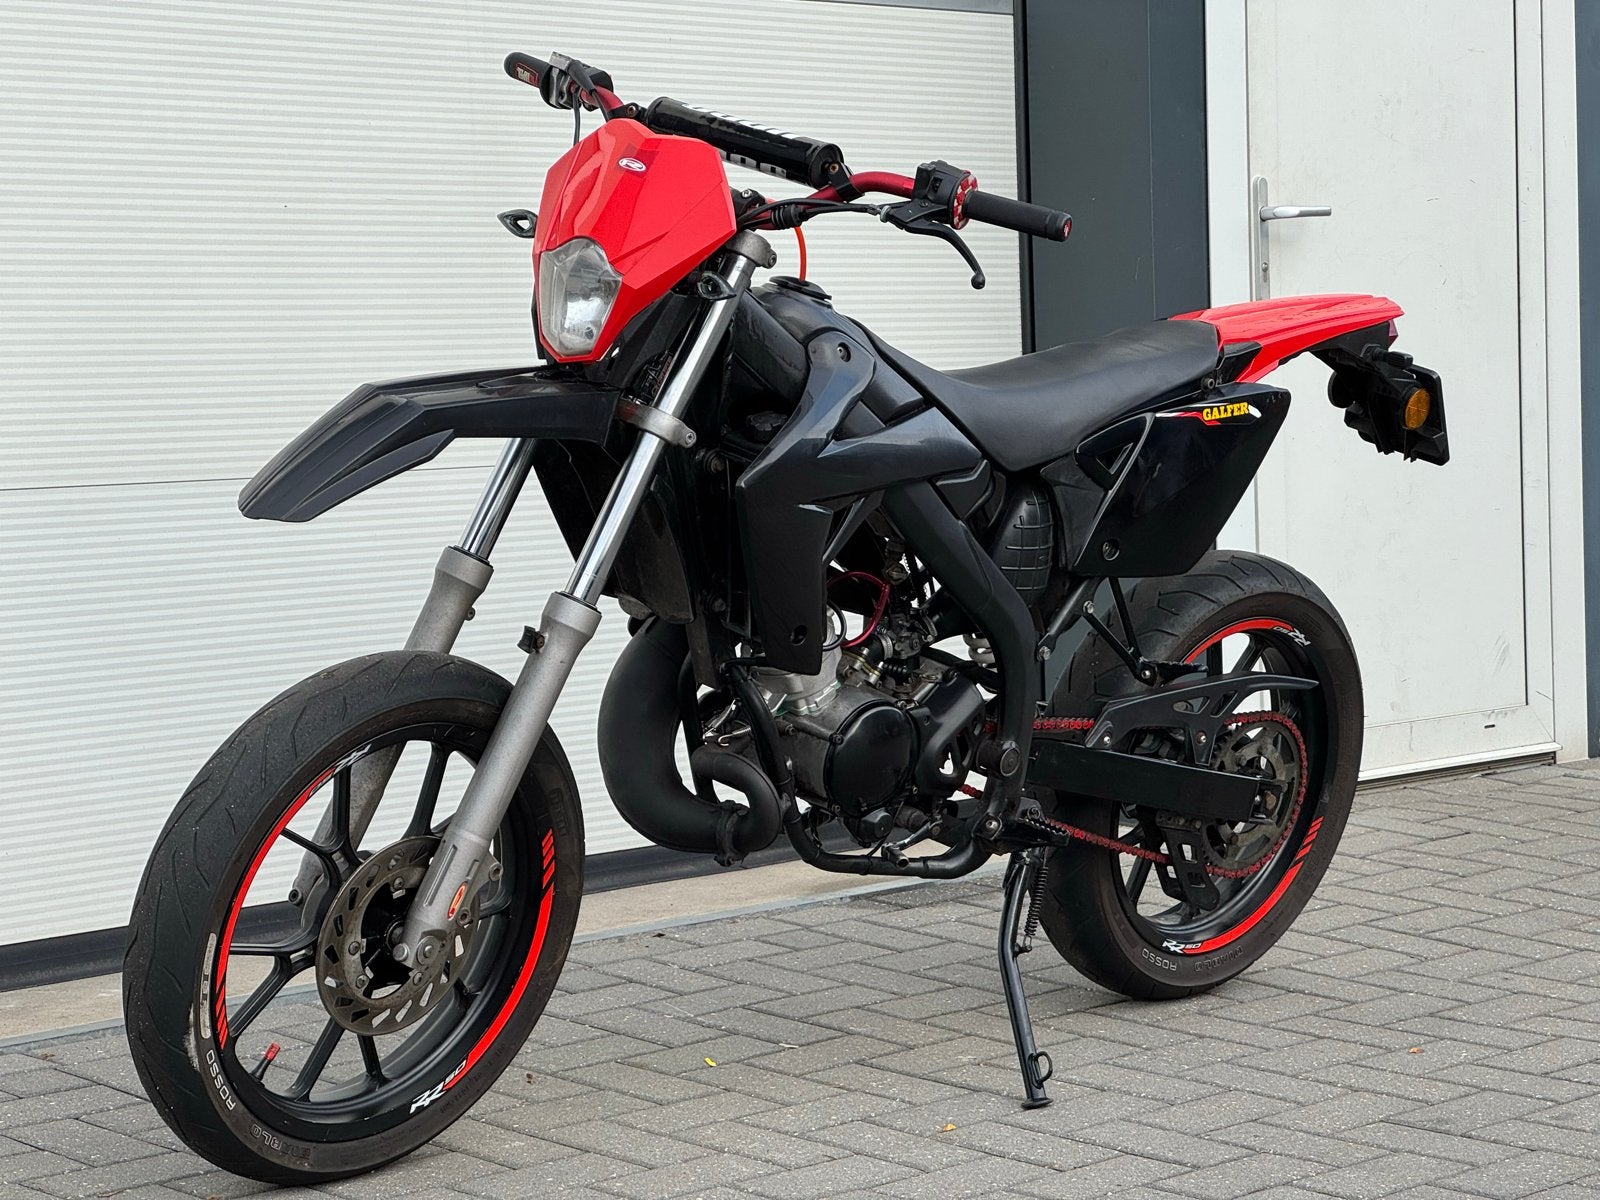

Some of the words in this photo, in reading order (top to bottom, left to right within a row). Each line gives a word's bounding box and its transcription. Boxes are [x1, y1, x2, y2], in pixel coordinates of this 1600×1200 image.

[1202, 402, 1249, 421] GALFER
[1142, 948, 1177, 971] ROSSO
[206, 1050, 236, 1111] ROSSO
